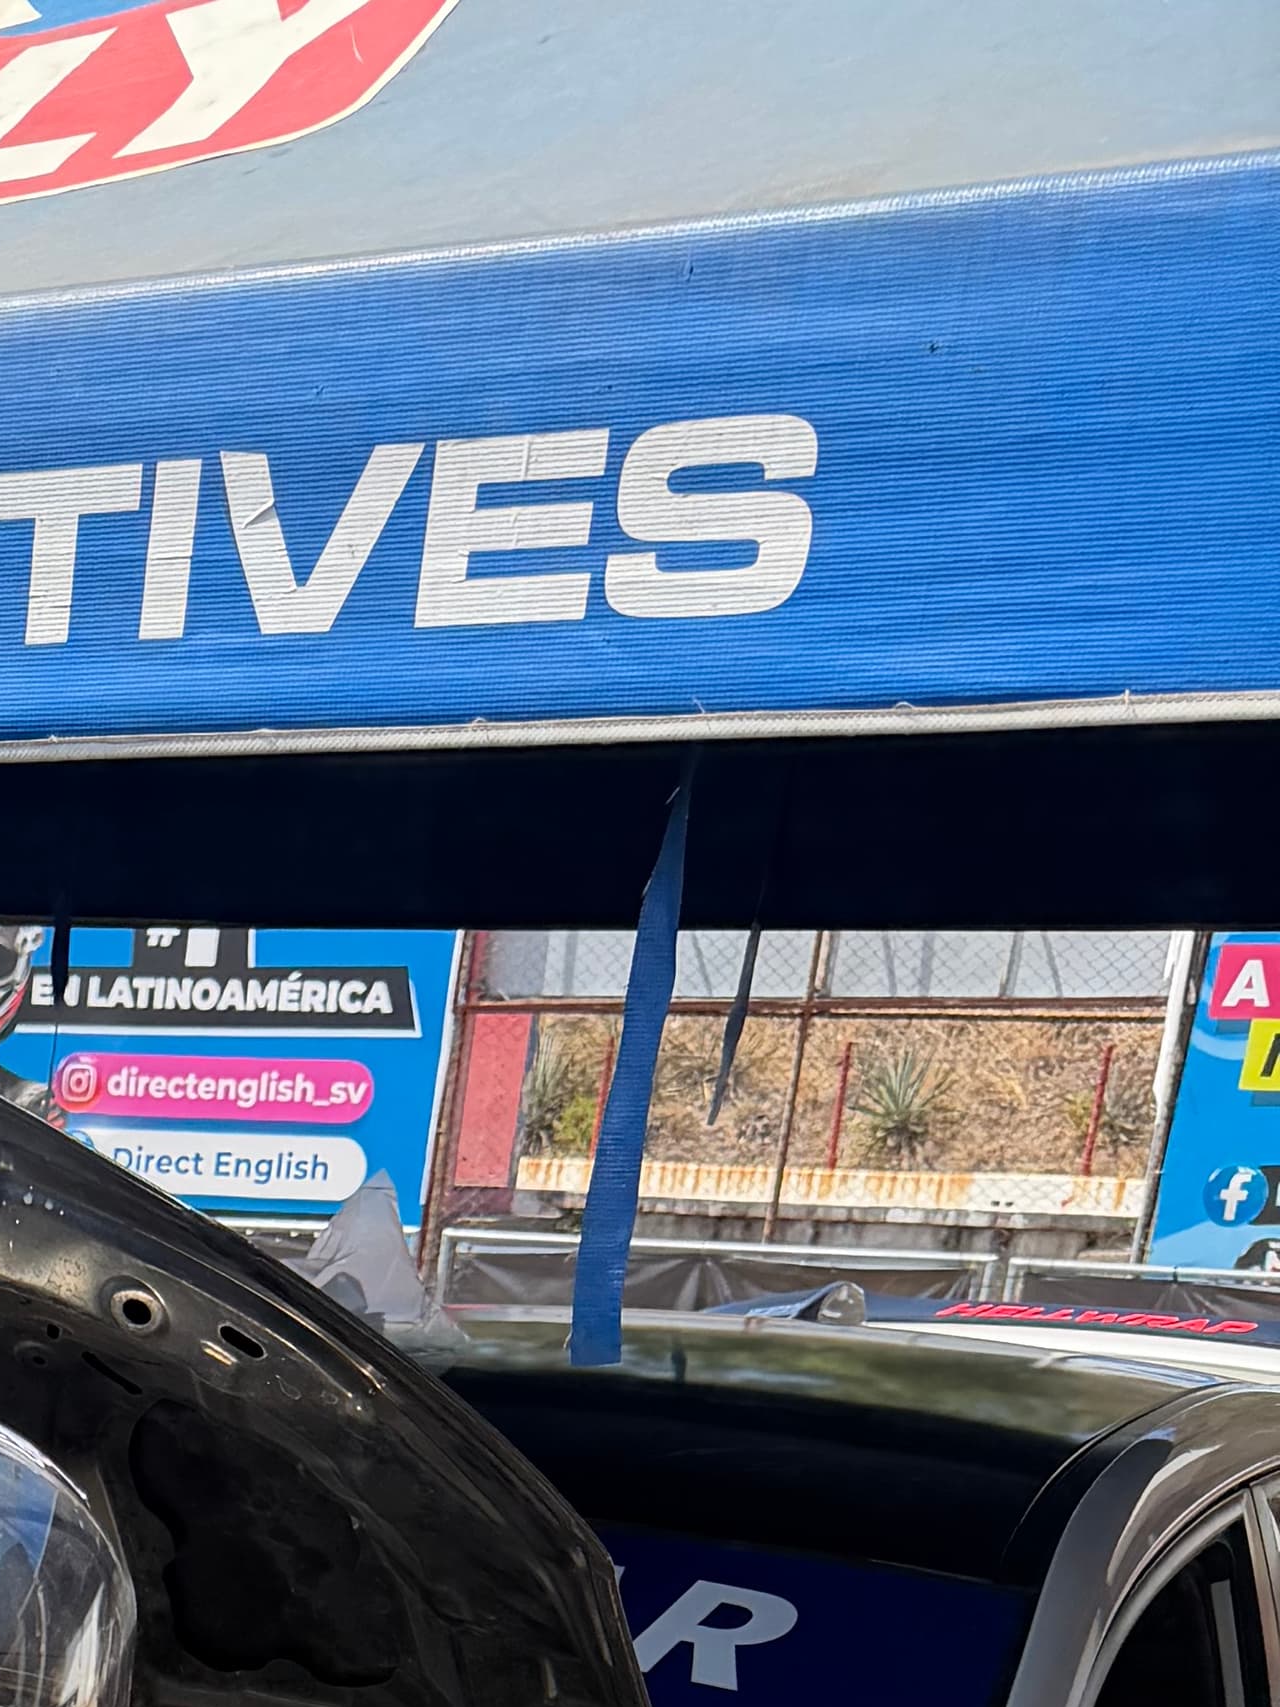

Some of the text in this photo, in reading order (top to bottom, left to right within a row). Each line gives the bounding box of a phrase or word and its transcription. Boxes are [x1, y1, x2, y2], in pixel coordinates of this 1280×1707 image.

[87, 970, 393, 1014] LATINOAMÉRICA
[107, 1066, 369, 1108] directenglish_sv
[114, 1146, 329, 1185] Direct English
[935, 1302, 1259, 1333] HELLWRAP
[612, 1564, 798, 1691] R
